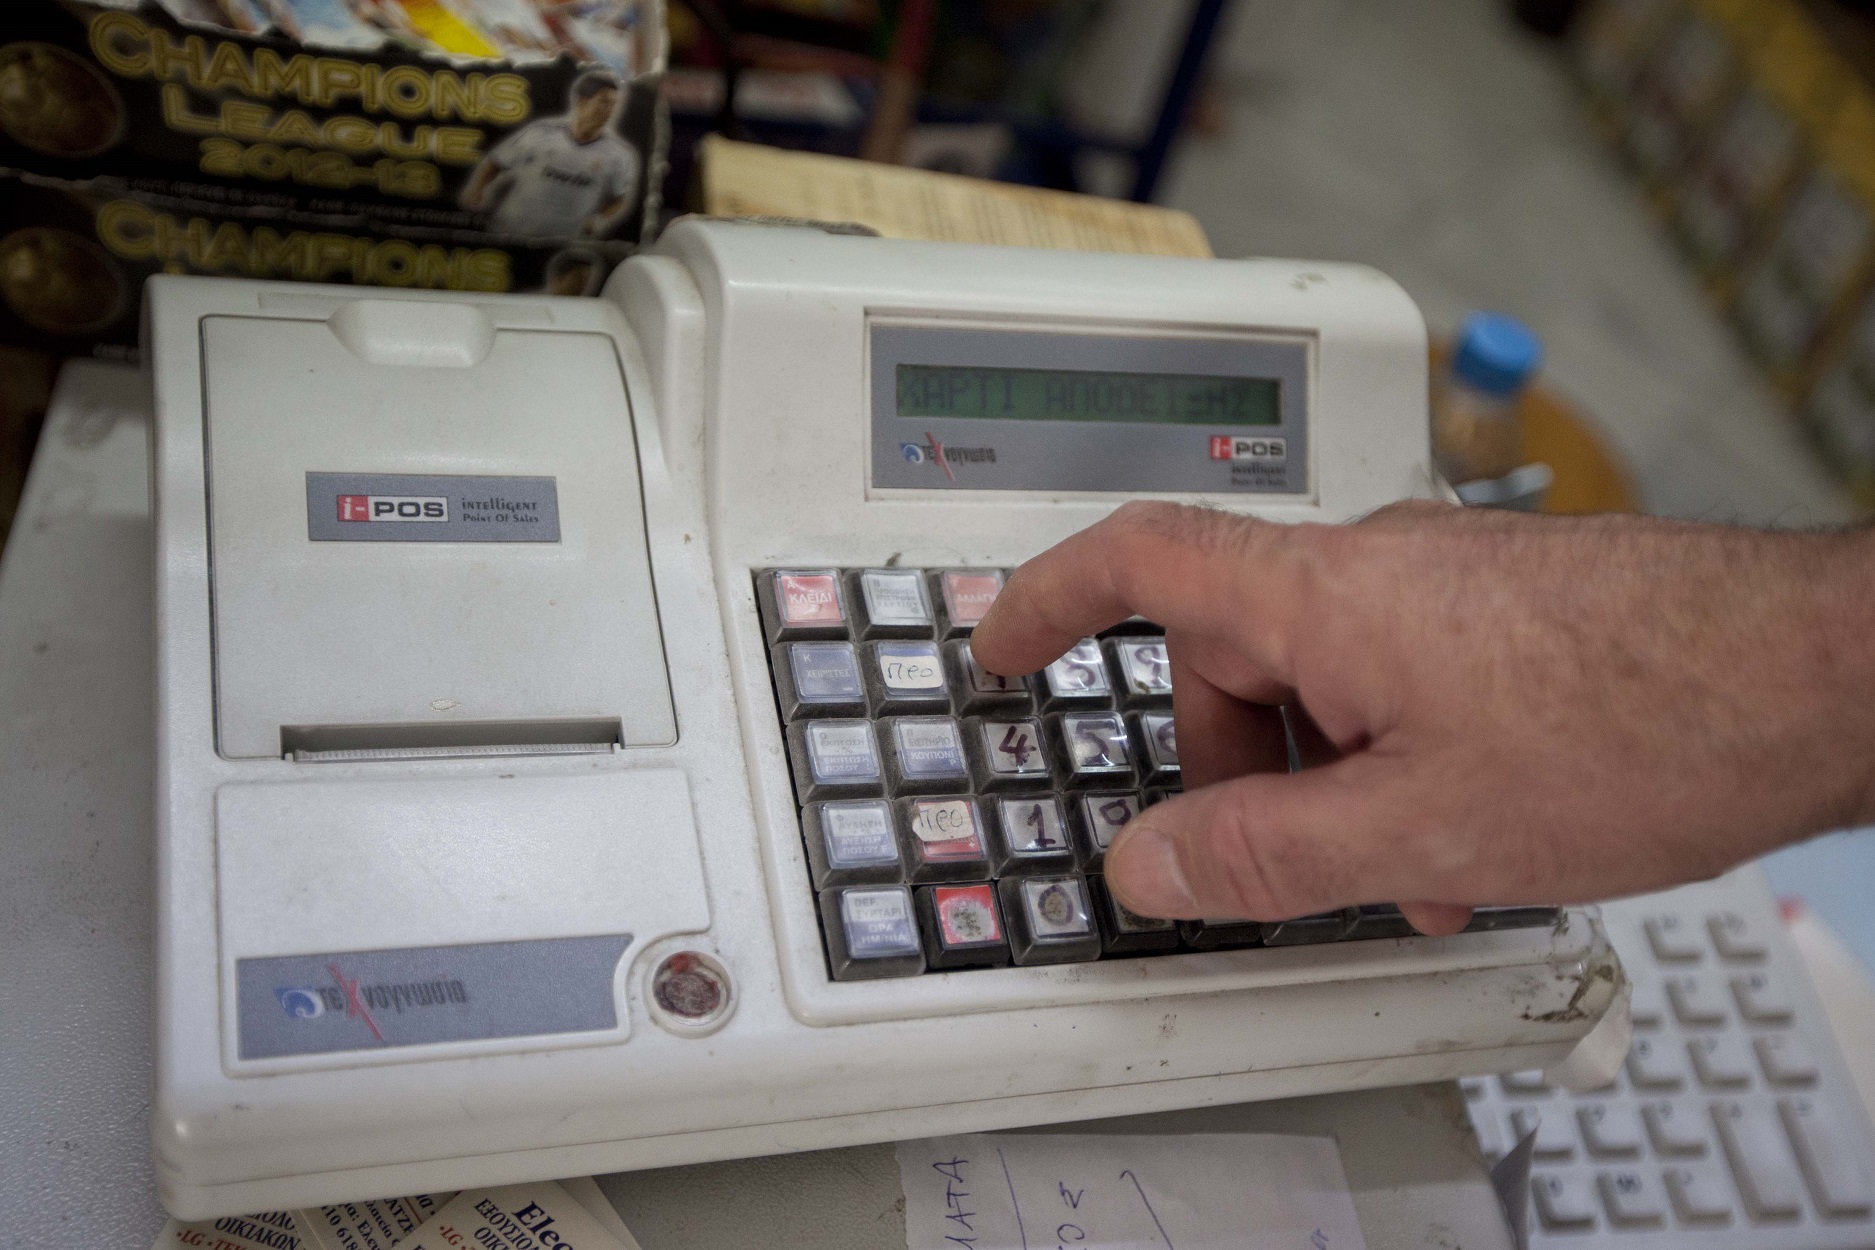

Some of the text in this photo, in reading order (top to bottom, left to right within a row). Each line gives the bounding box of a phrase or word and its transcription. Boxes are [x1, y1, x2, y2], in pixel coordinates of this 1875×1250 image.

[90, 11, 531, 125] CHAMPIONS
[162, 83, 485, 166] LEAGUE
[198, 138, 442, 199] 2012-13
[96, 199, 514, 292] CHAMPIONS
[343, 497, 445, 520] i-POS
[789, 592, 832, 603] ΚΛΕΙΔΙ
[1134, 646, 1161, 687] 9
[999, 725, 1037, 766] 4
[1075, 721, 1115, 764] 5
[1026, 804, 1056, 848] 1
